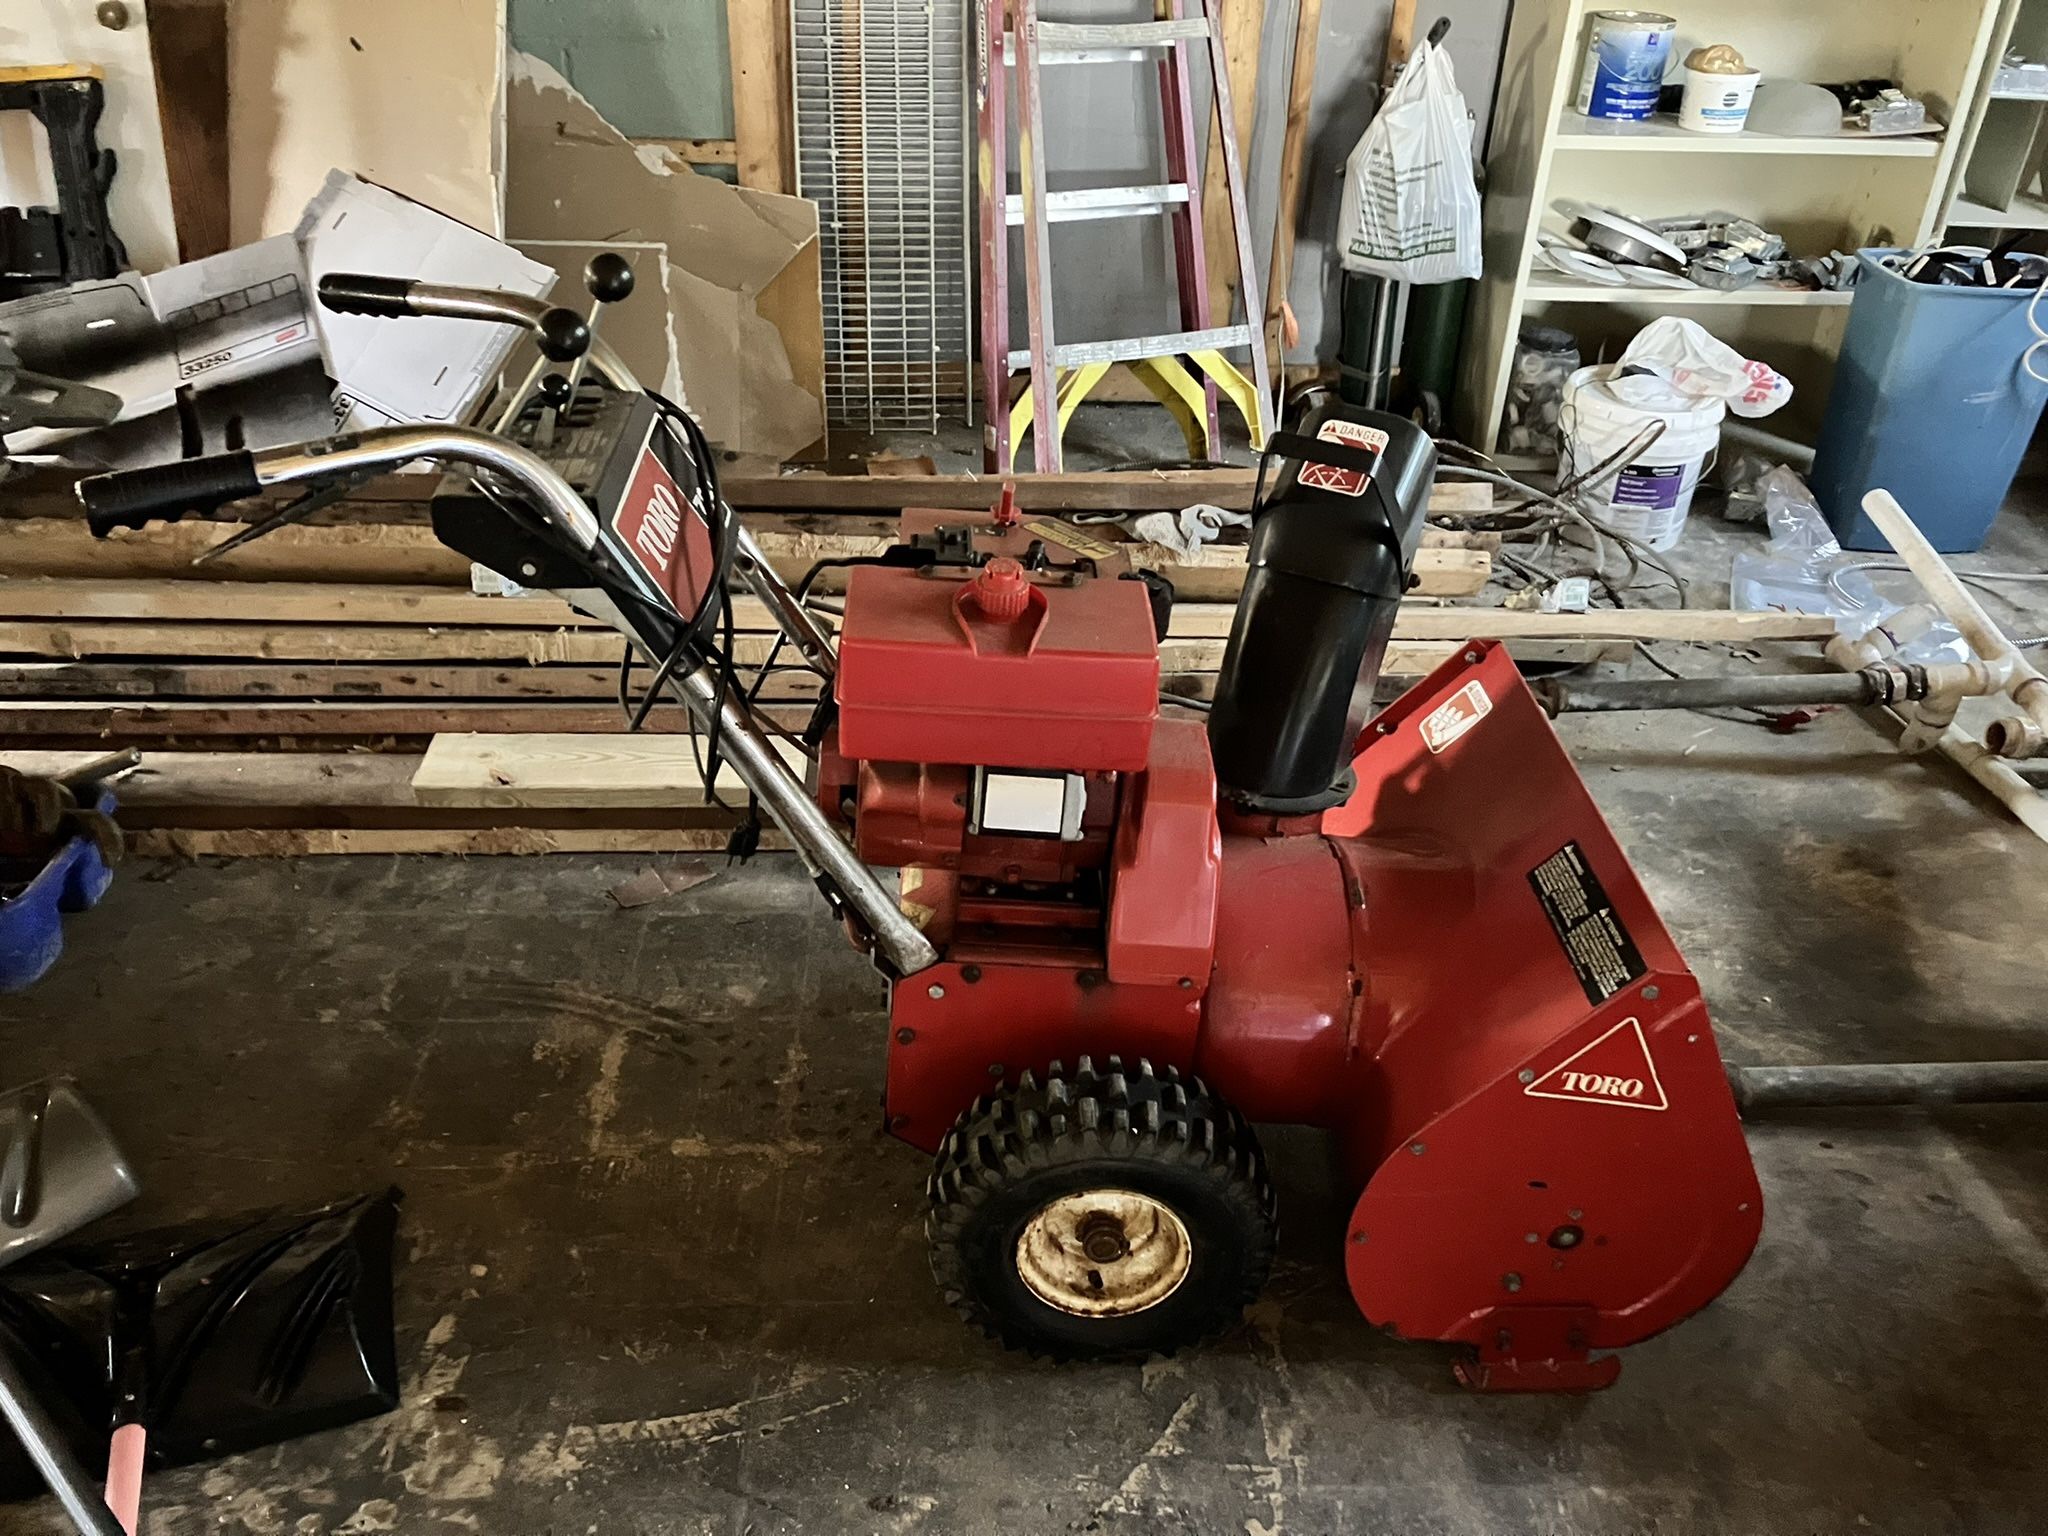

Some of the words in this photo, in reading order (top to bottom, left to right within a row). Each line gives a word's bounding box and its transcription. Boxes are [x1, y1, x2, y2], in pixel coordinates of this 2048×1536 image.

[184, 352, 232, 376] 33250
[1340, 424, 1386, 443] DANGER
[636, 483, 681, 572] TORO
[1561, 1071, 1644, 1099] TORO
